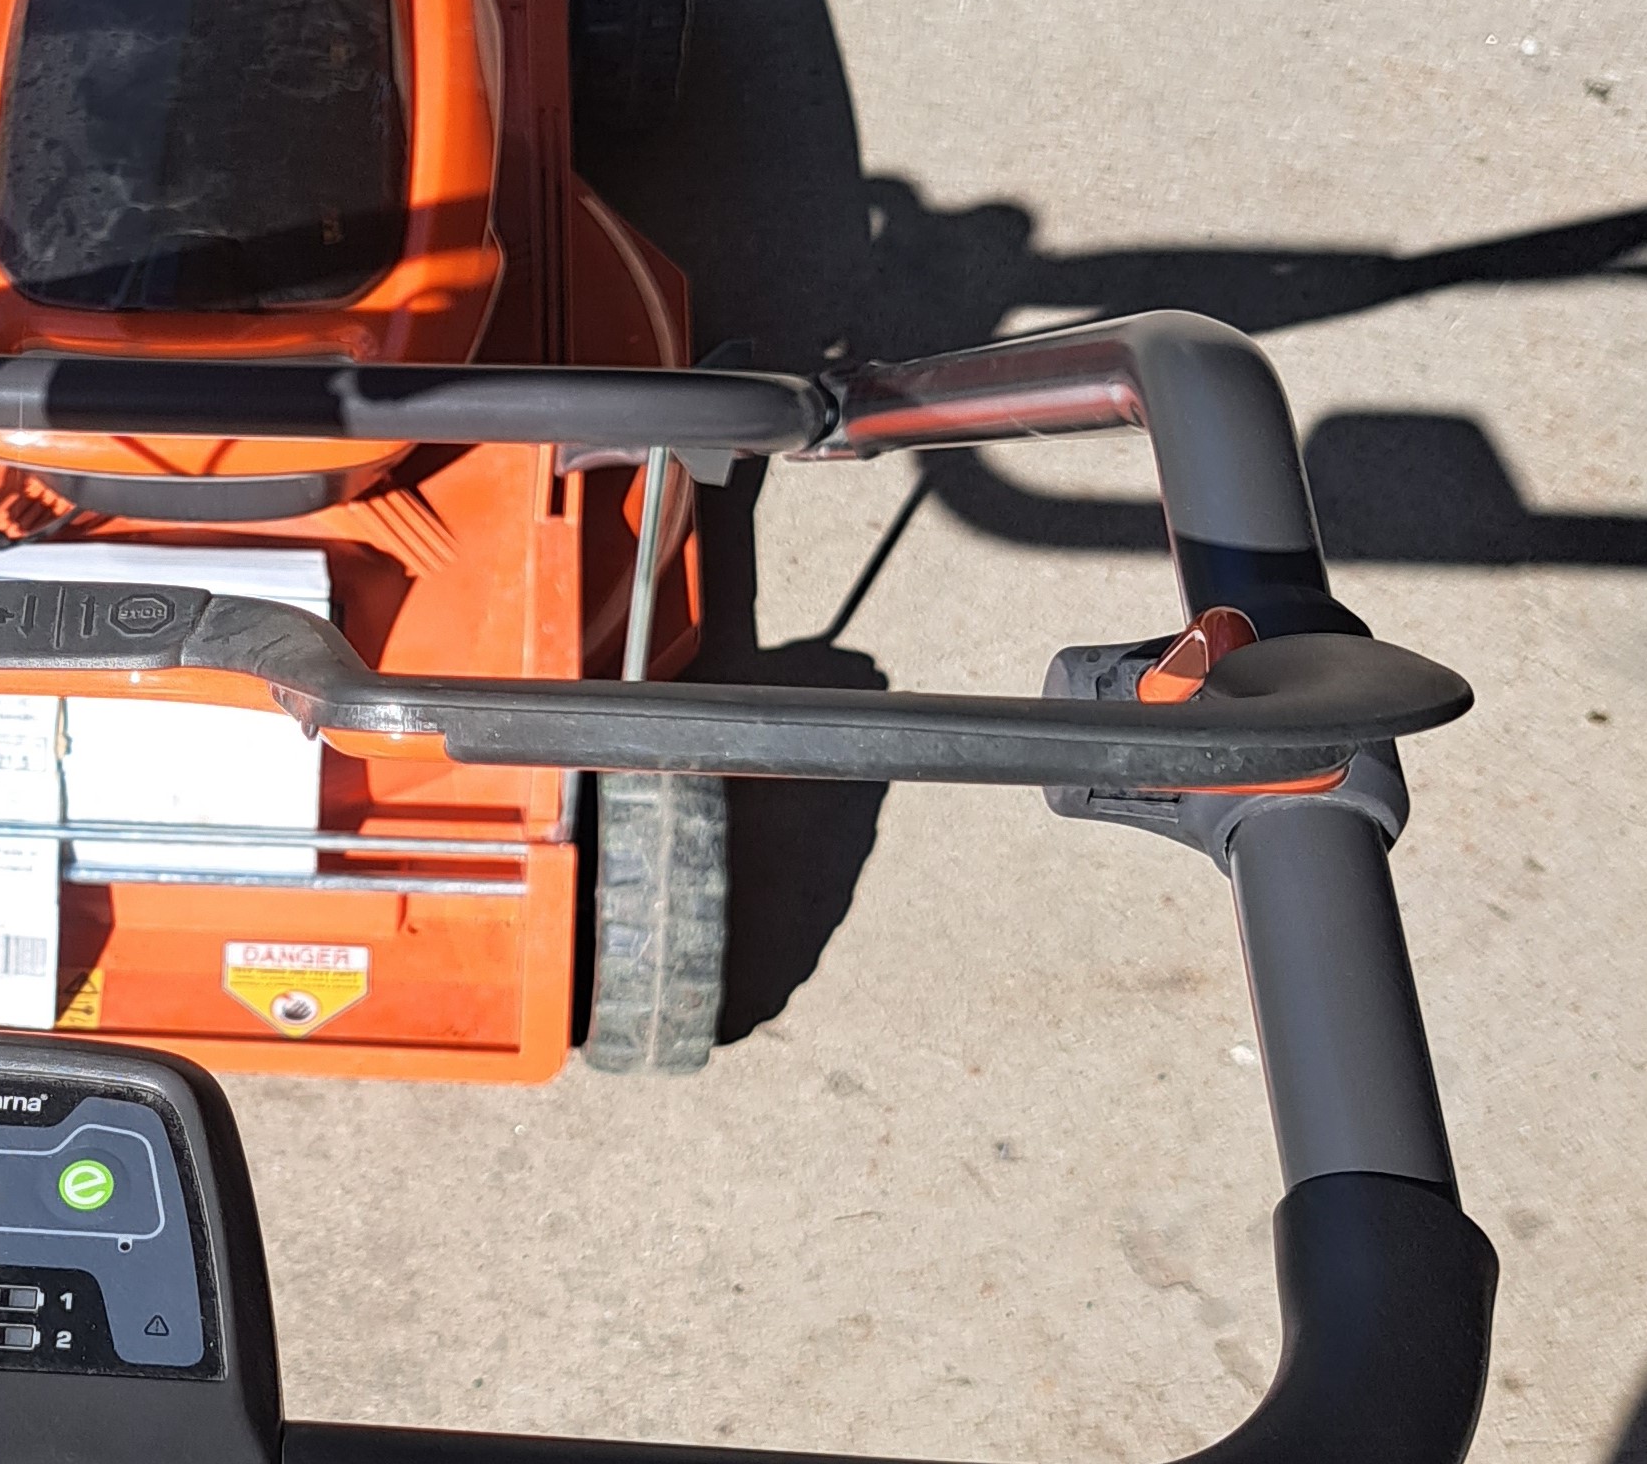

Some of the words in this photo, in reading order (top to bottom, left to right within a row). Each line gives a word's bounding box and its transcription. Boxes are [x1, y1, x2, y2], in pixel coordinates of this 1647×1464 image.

[242, 945, 350, 965] DANGER
[59, 1292, 73, 1310] 1
[55, 1330, 72, 1349] 2
